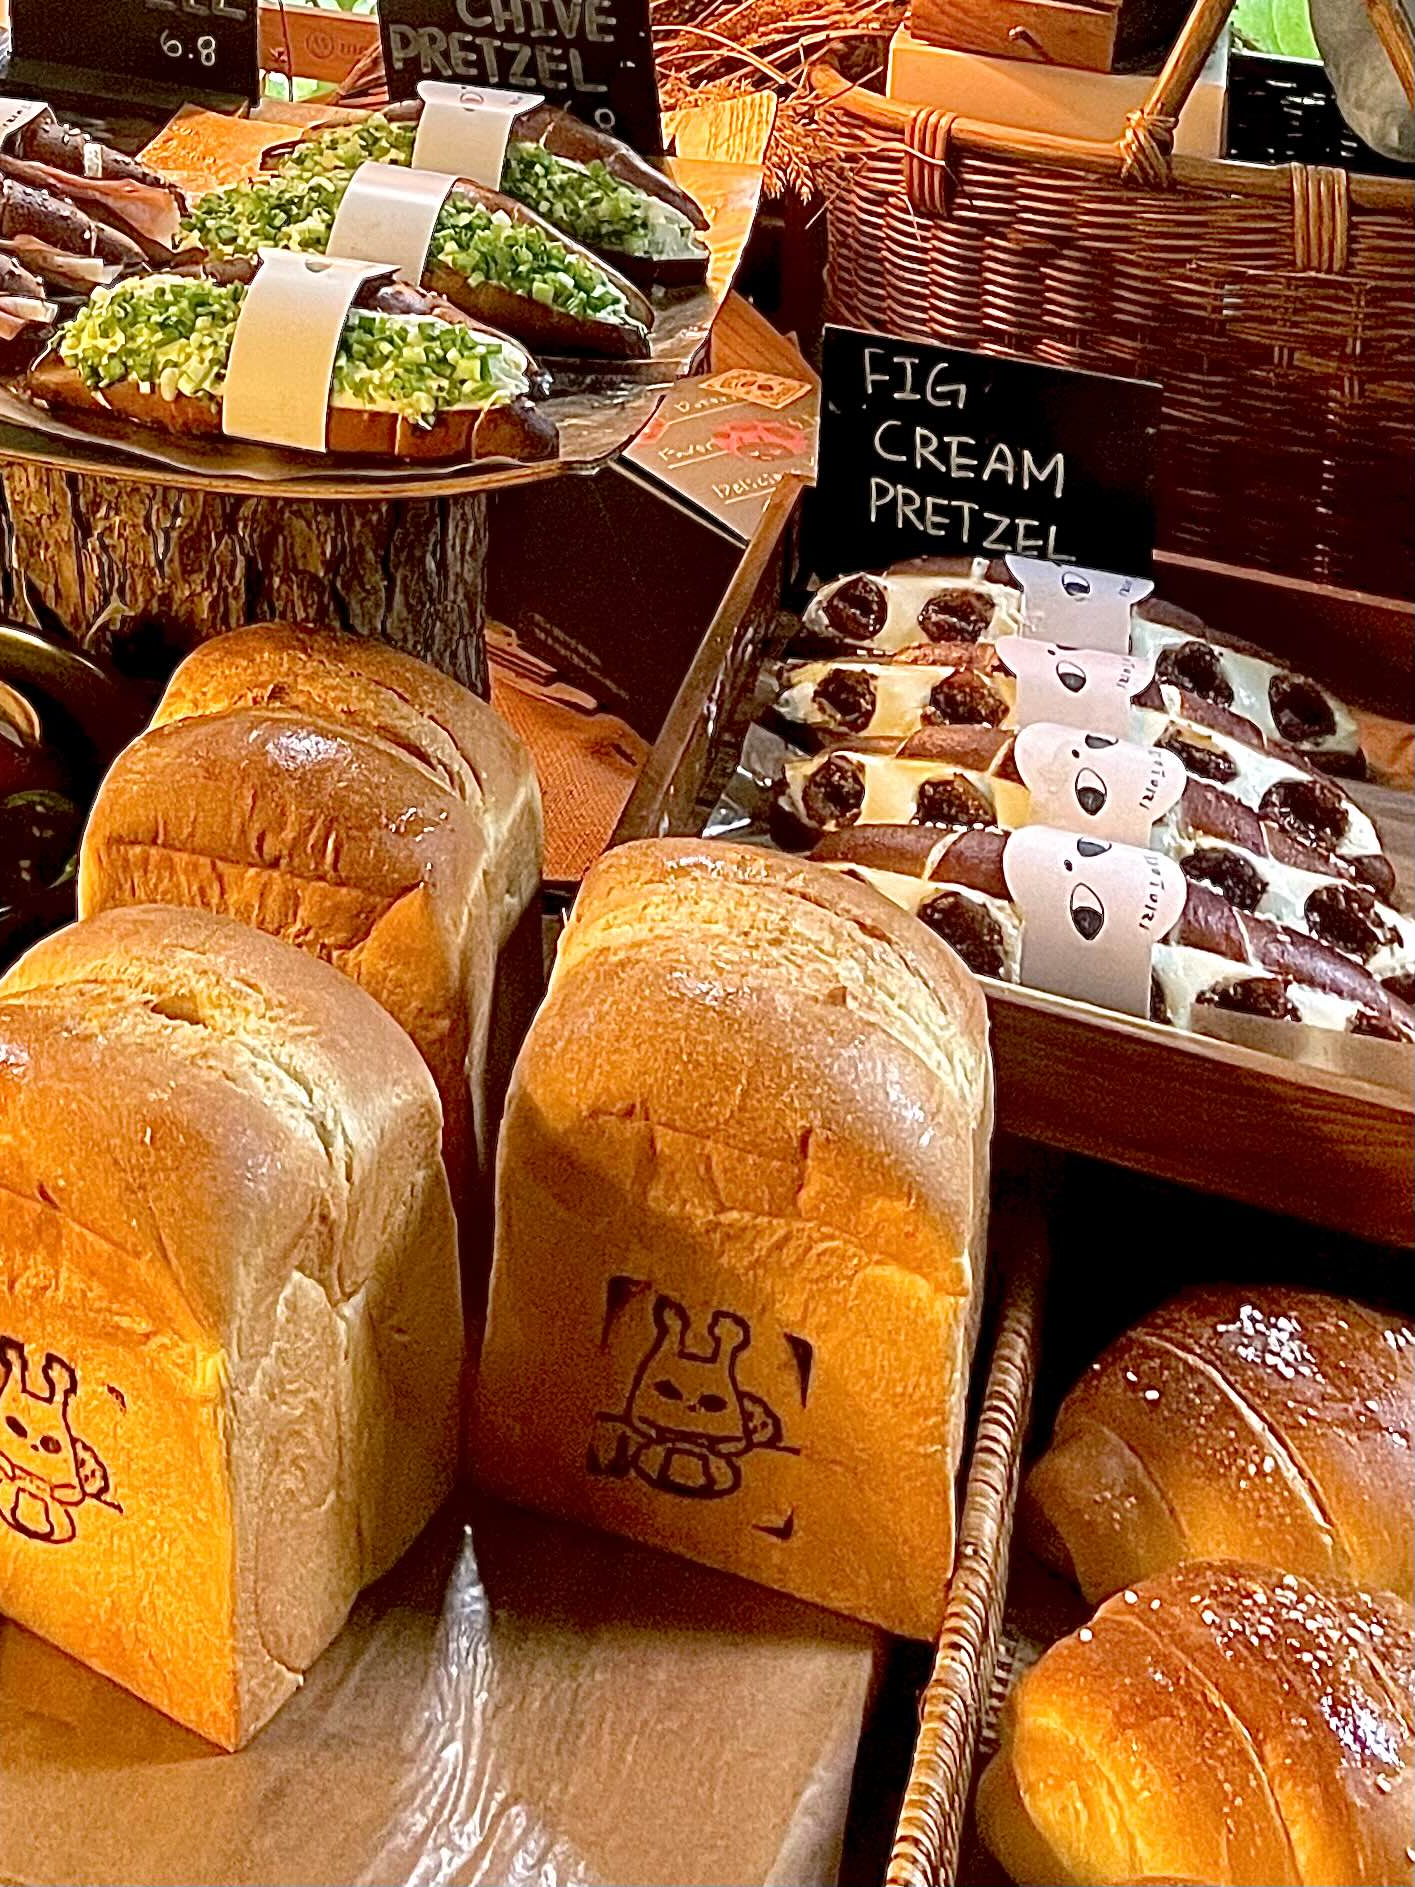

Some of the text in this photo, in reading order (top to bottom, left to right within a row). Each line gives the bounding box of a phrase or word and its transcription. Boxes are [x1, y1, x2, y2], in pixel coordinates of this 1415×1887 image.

[160, 28, 217, 66] 6.8
[388, 23, 608, 93] PRETZEL
[864, 348, 967, 409] FIG
[712, 473, 784, 499] Delicio
[874, 420, 1066, 499] CREAM
[871, 477, 1077, 561] PRETZEL
